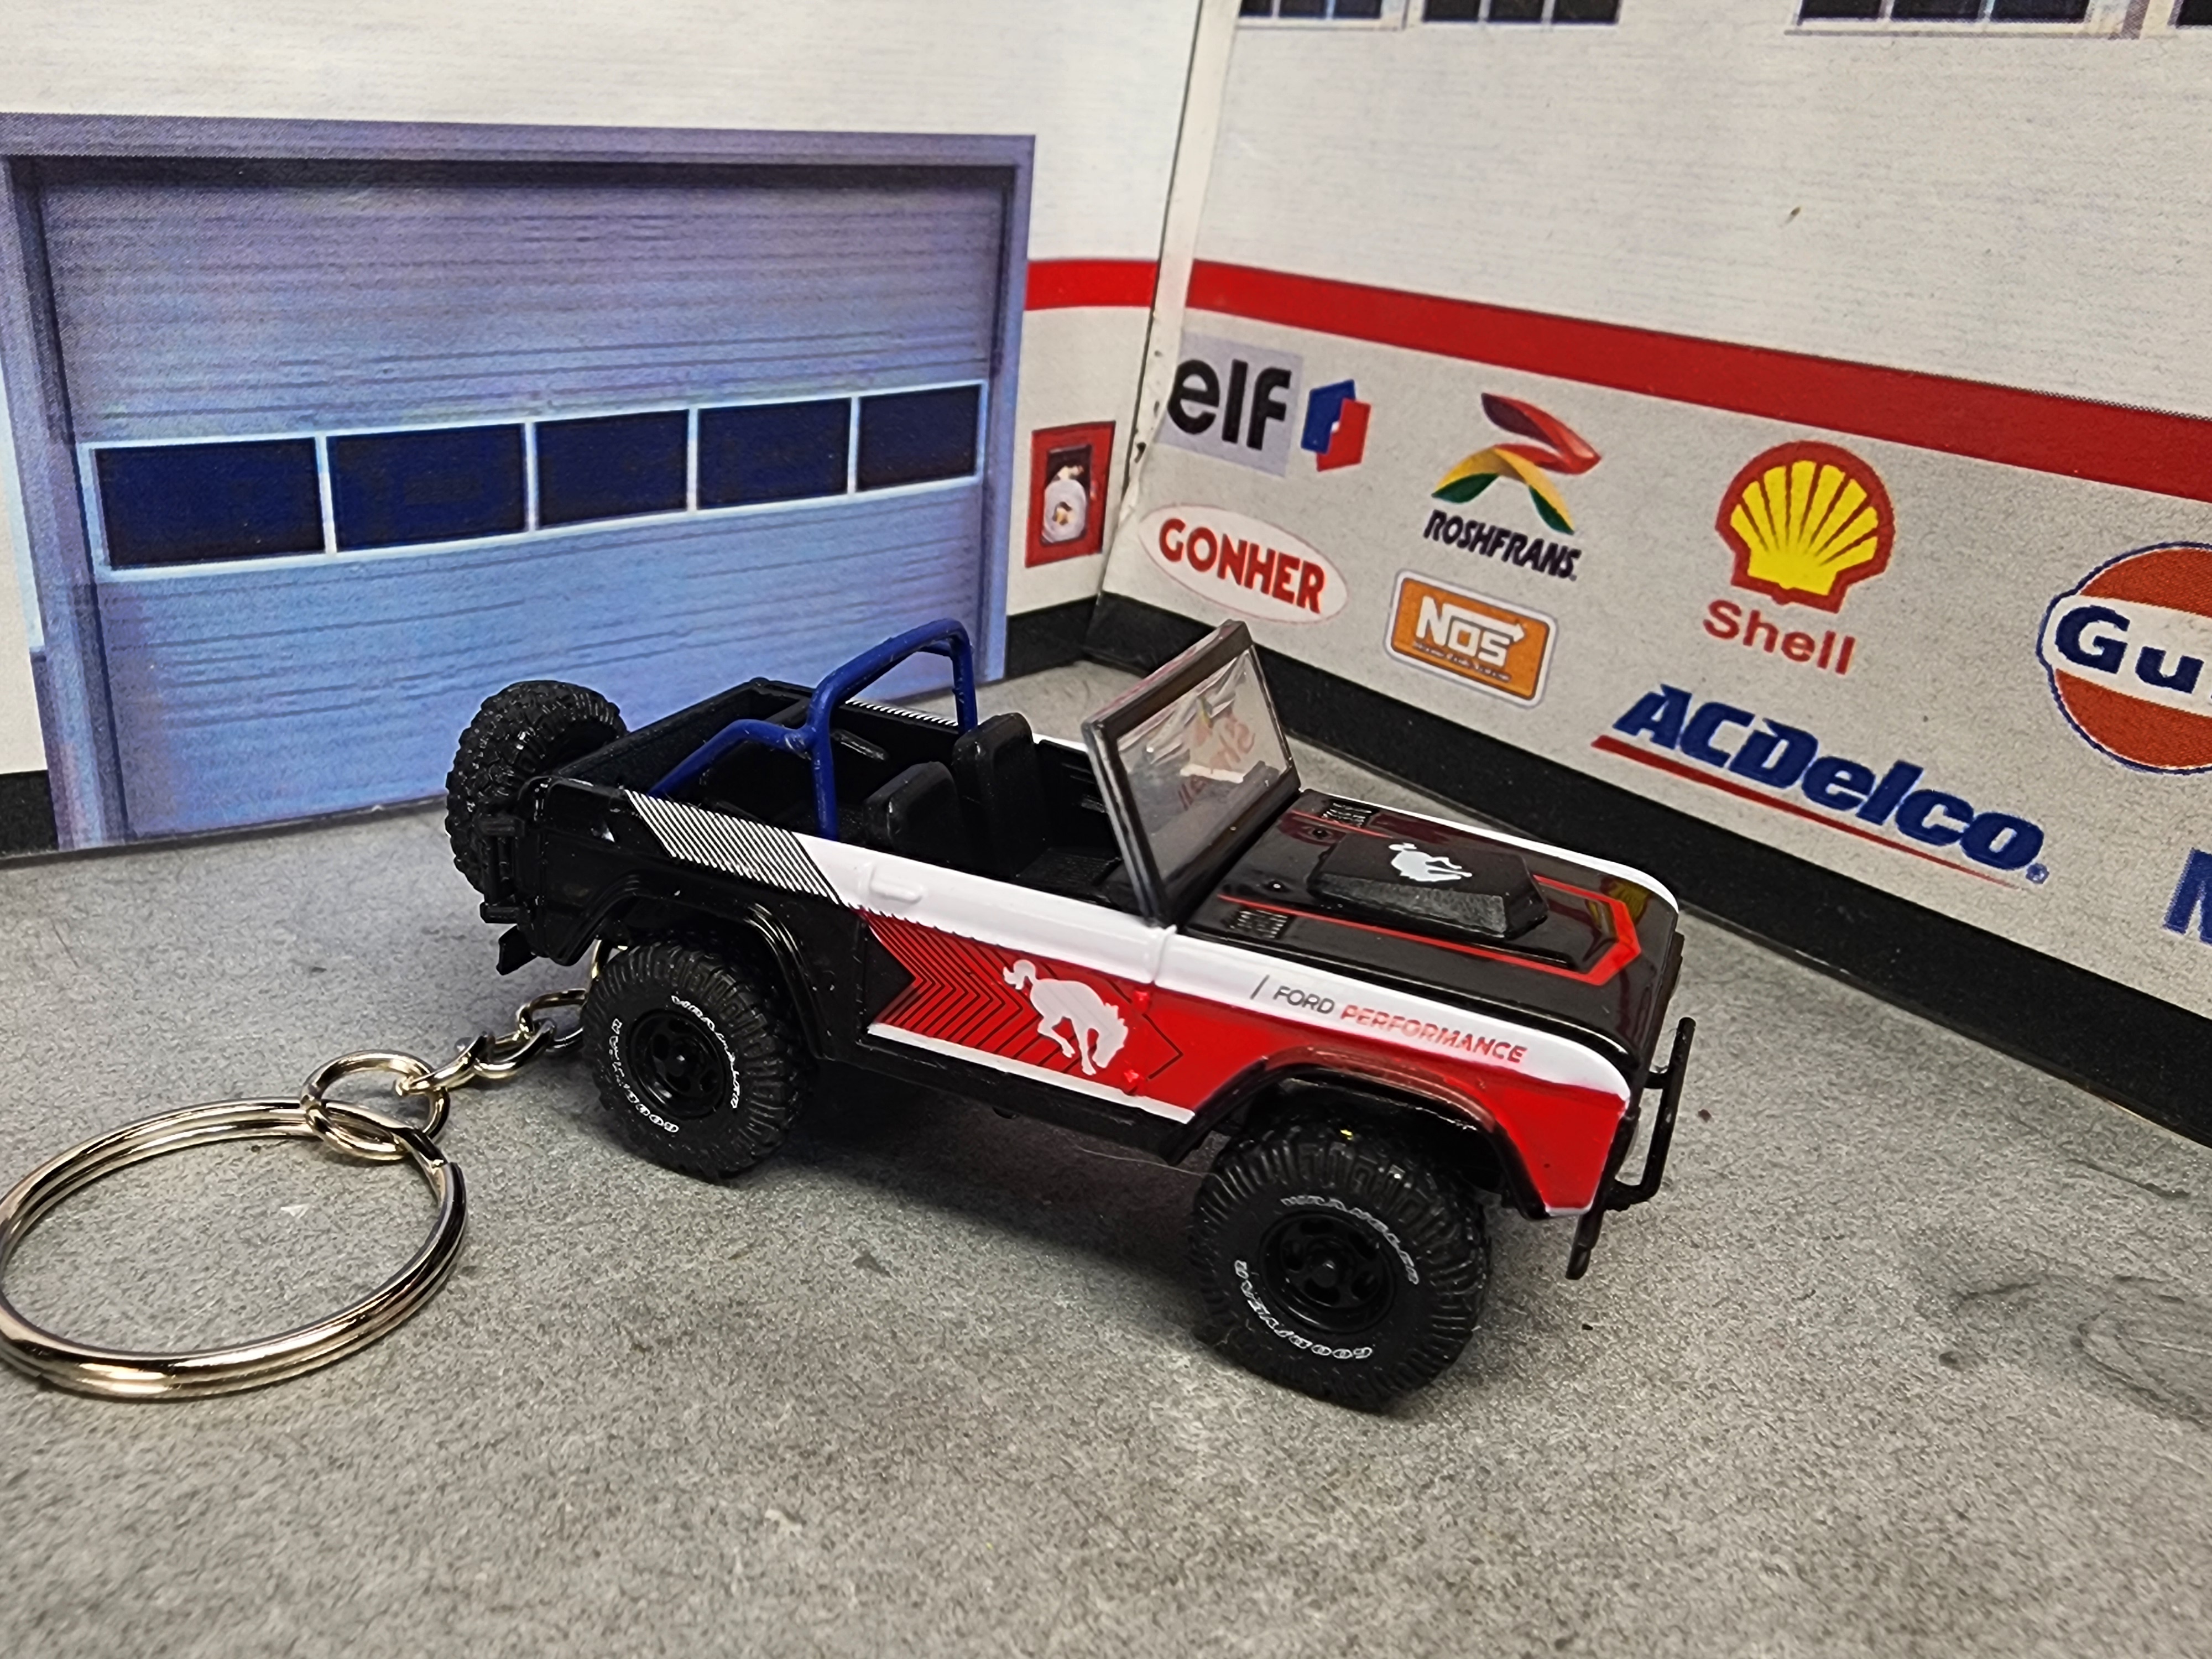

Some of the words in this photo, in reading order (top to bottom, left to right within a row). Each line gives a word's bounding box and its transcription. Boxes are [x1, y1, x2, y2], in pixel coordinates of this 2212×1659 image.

[1167, 358, 1292, 451] elf
[1159, 518, 1325, 614] GONHER
[1423, 509, 1582, 578] ROSHFRANS
[1416, 596, 1525, 667] NOS
[1703, 599, 1855, 675] Shell
[2054, 605, 2212, 698] Gu
[1613, 684, 2045, 870] ACDelco
[1273, 986, 1334, 1014] FORD
[1340, 1005, 1527, 1063] PERFORMANCE
